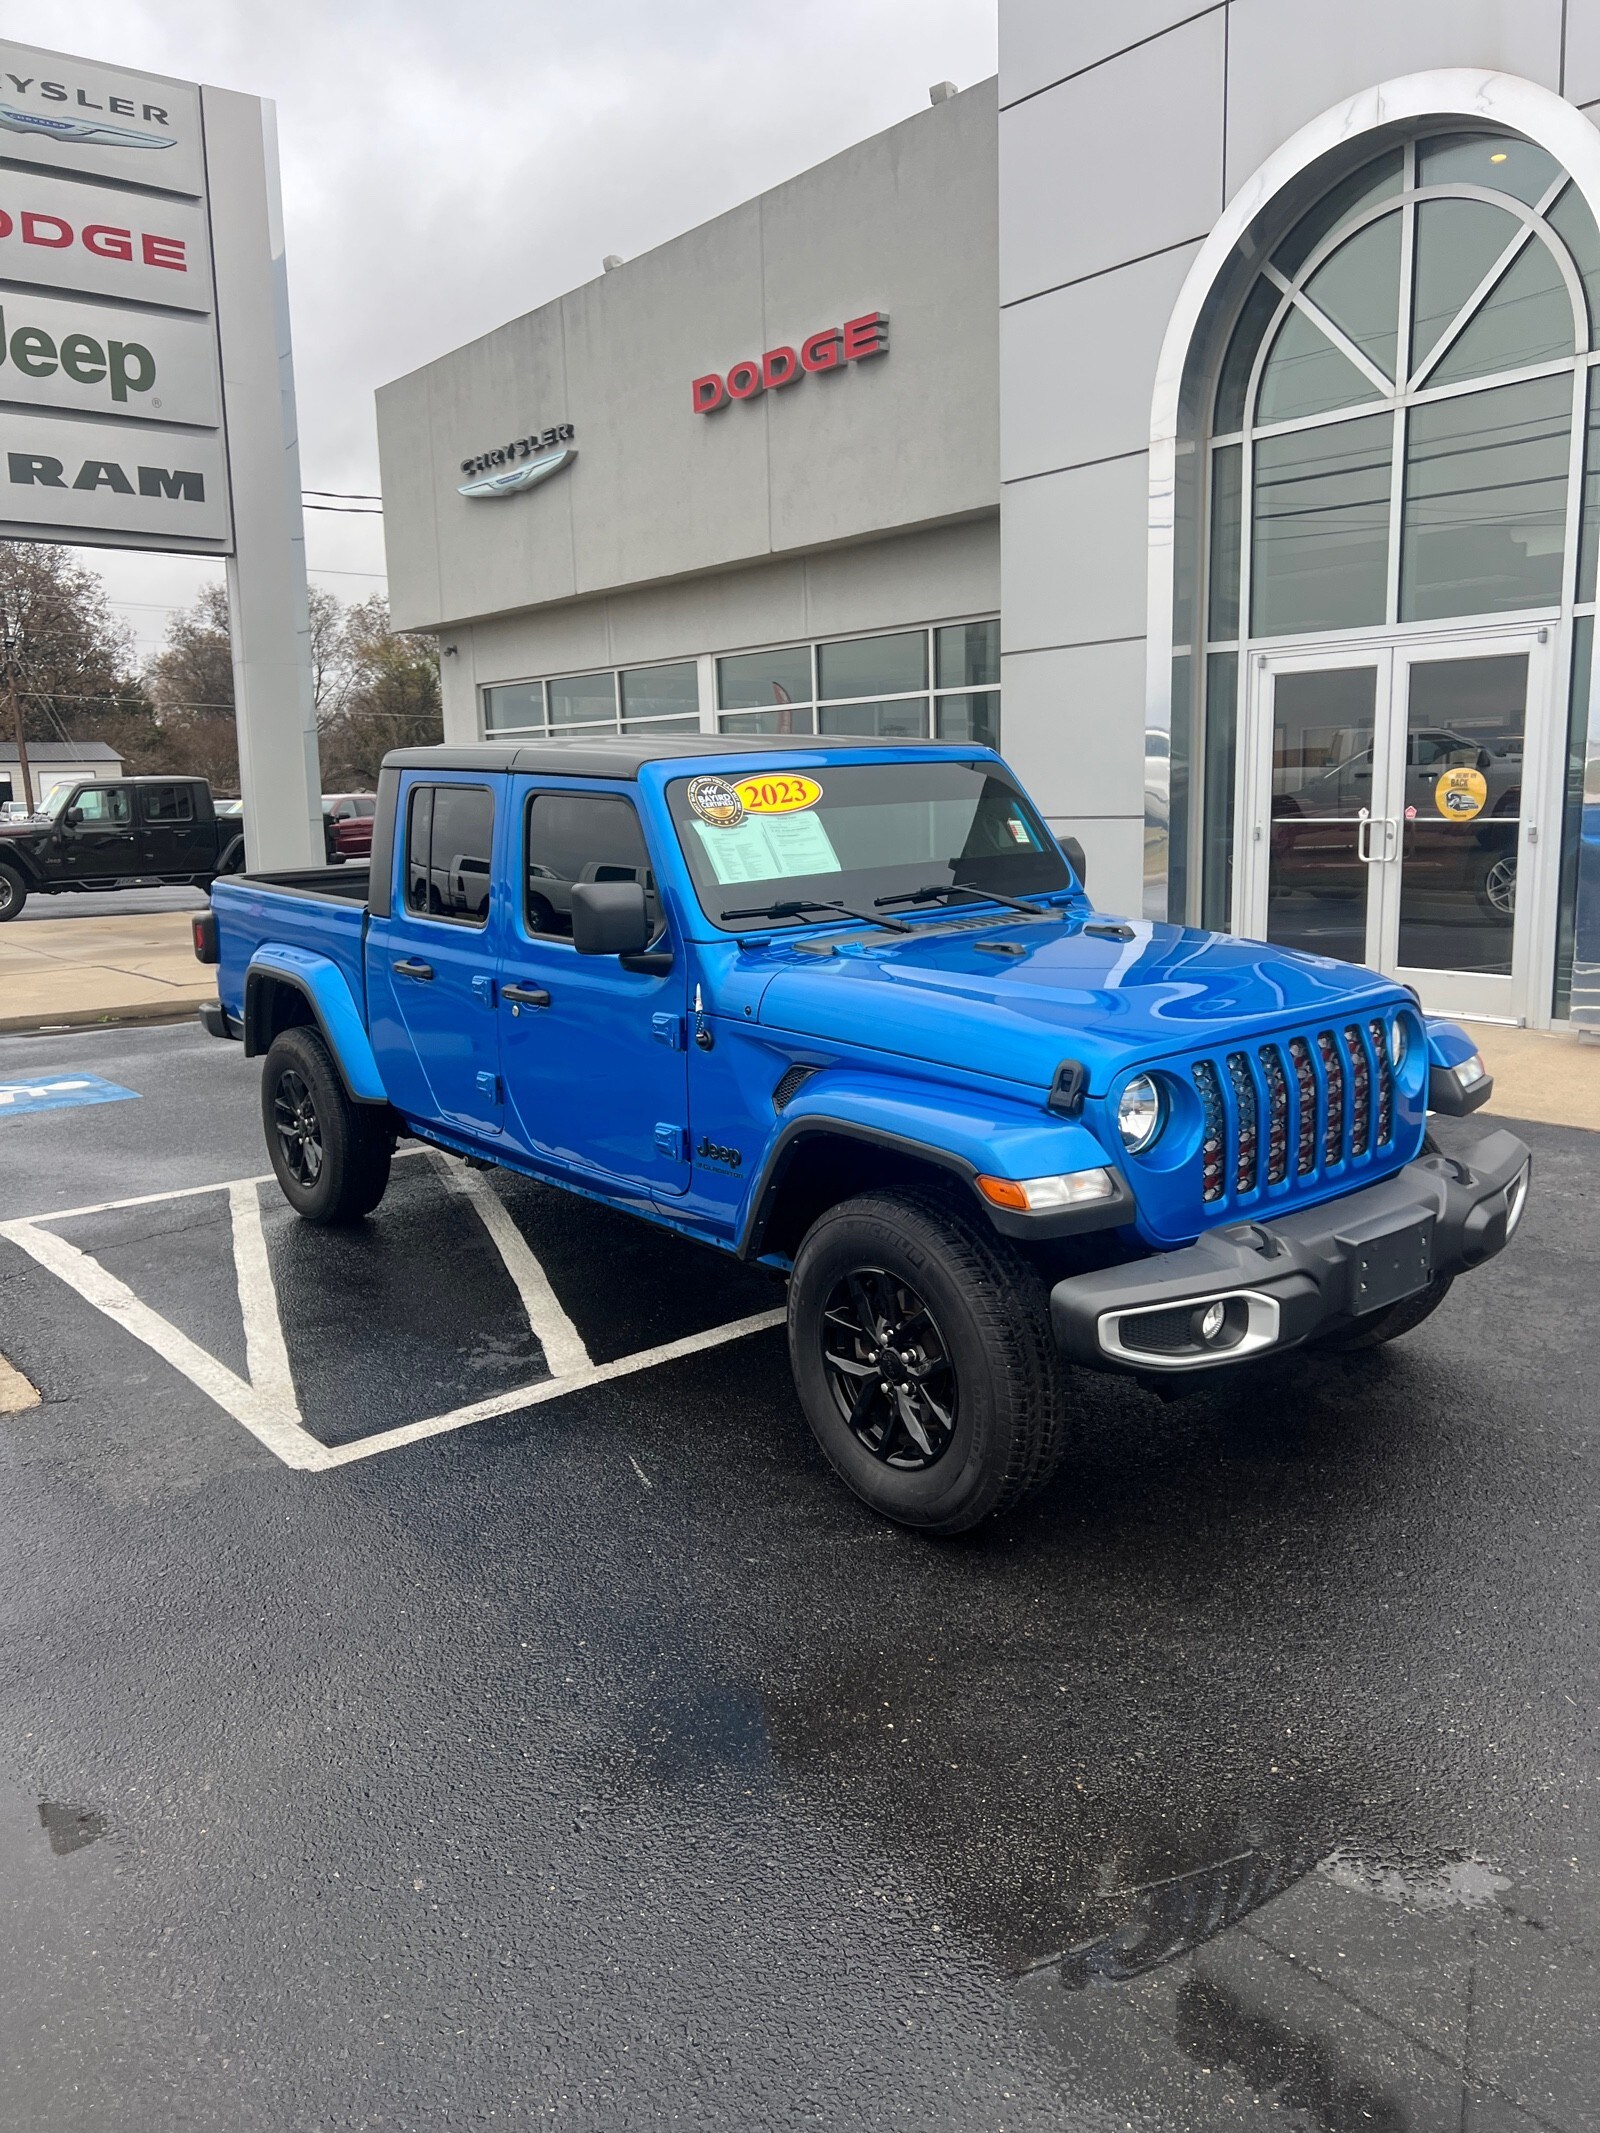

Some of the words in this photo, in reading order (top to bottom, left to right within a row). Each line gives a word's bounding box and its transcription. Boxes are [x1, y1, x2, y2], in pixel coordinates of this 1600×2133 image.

[0, 72, 170, 126] YSLER
[0, 210, 188, 273] DGE
[692, 311, 891, 414] DODGE
[460, 422, 575, 476] CHRYSLER
[8, 452, 206, 503] RAM
[698, 793, 731, 803] BAYIRD
[745, 780, 807, 808] 2023
[1451, 779, 1468, 787] BACK
[697, 1135, 742, 1169] Jeep
